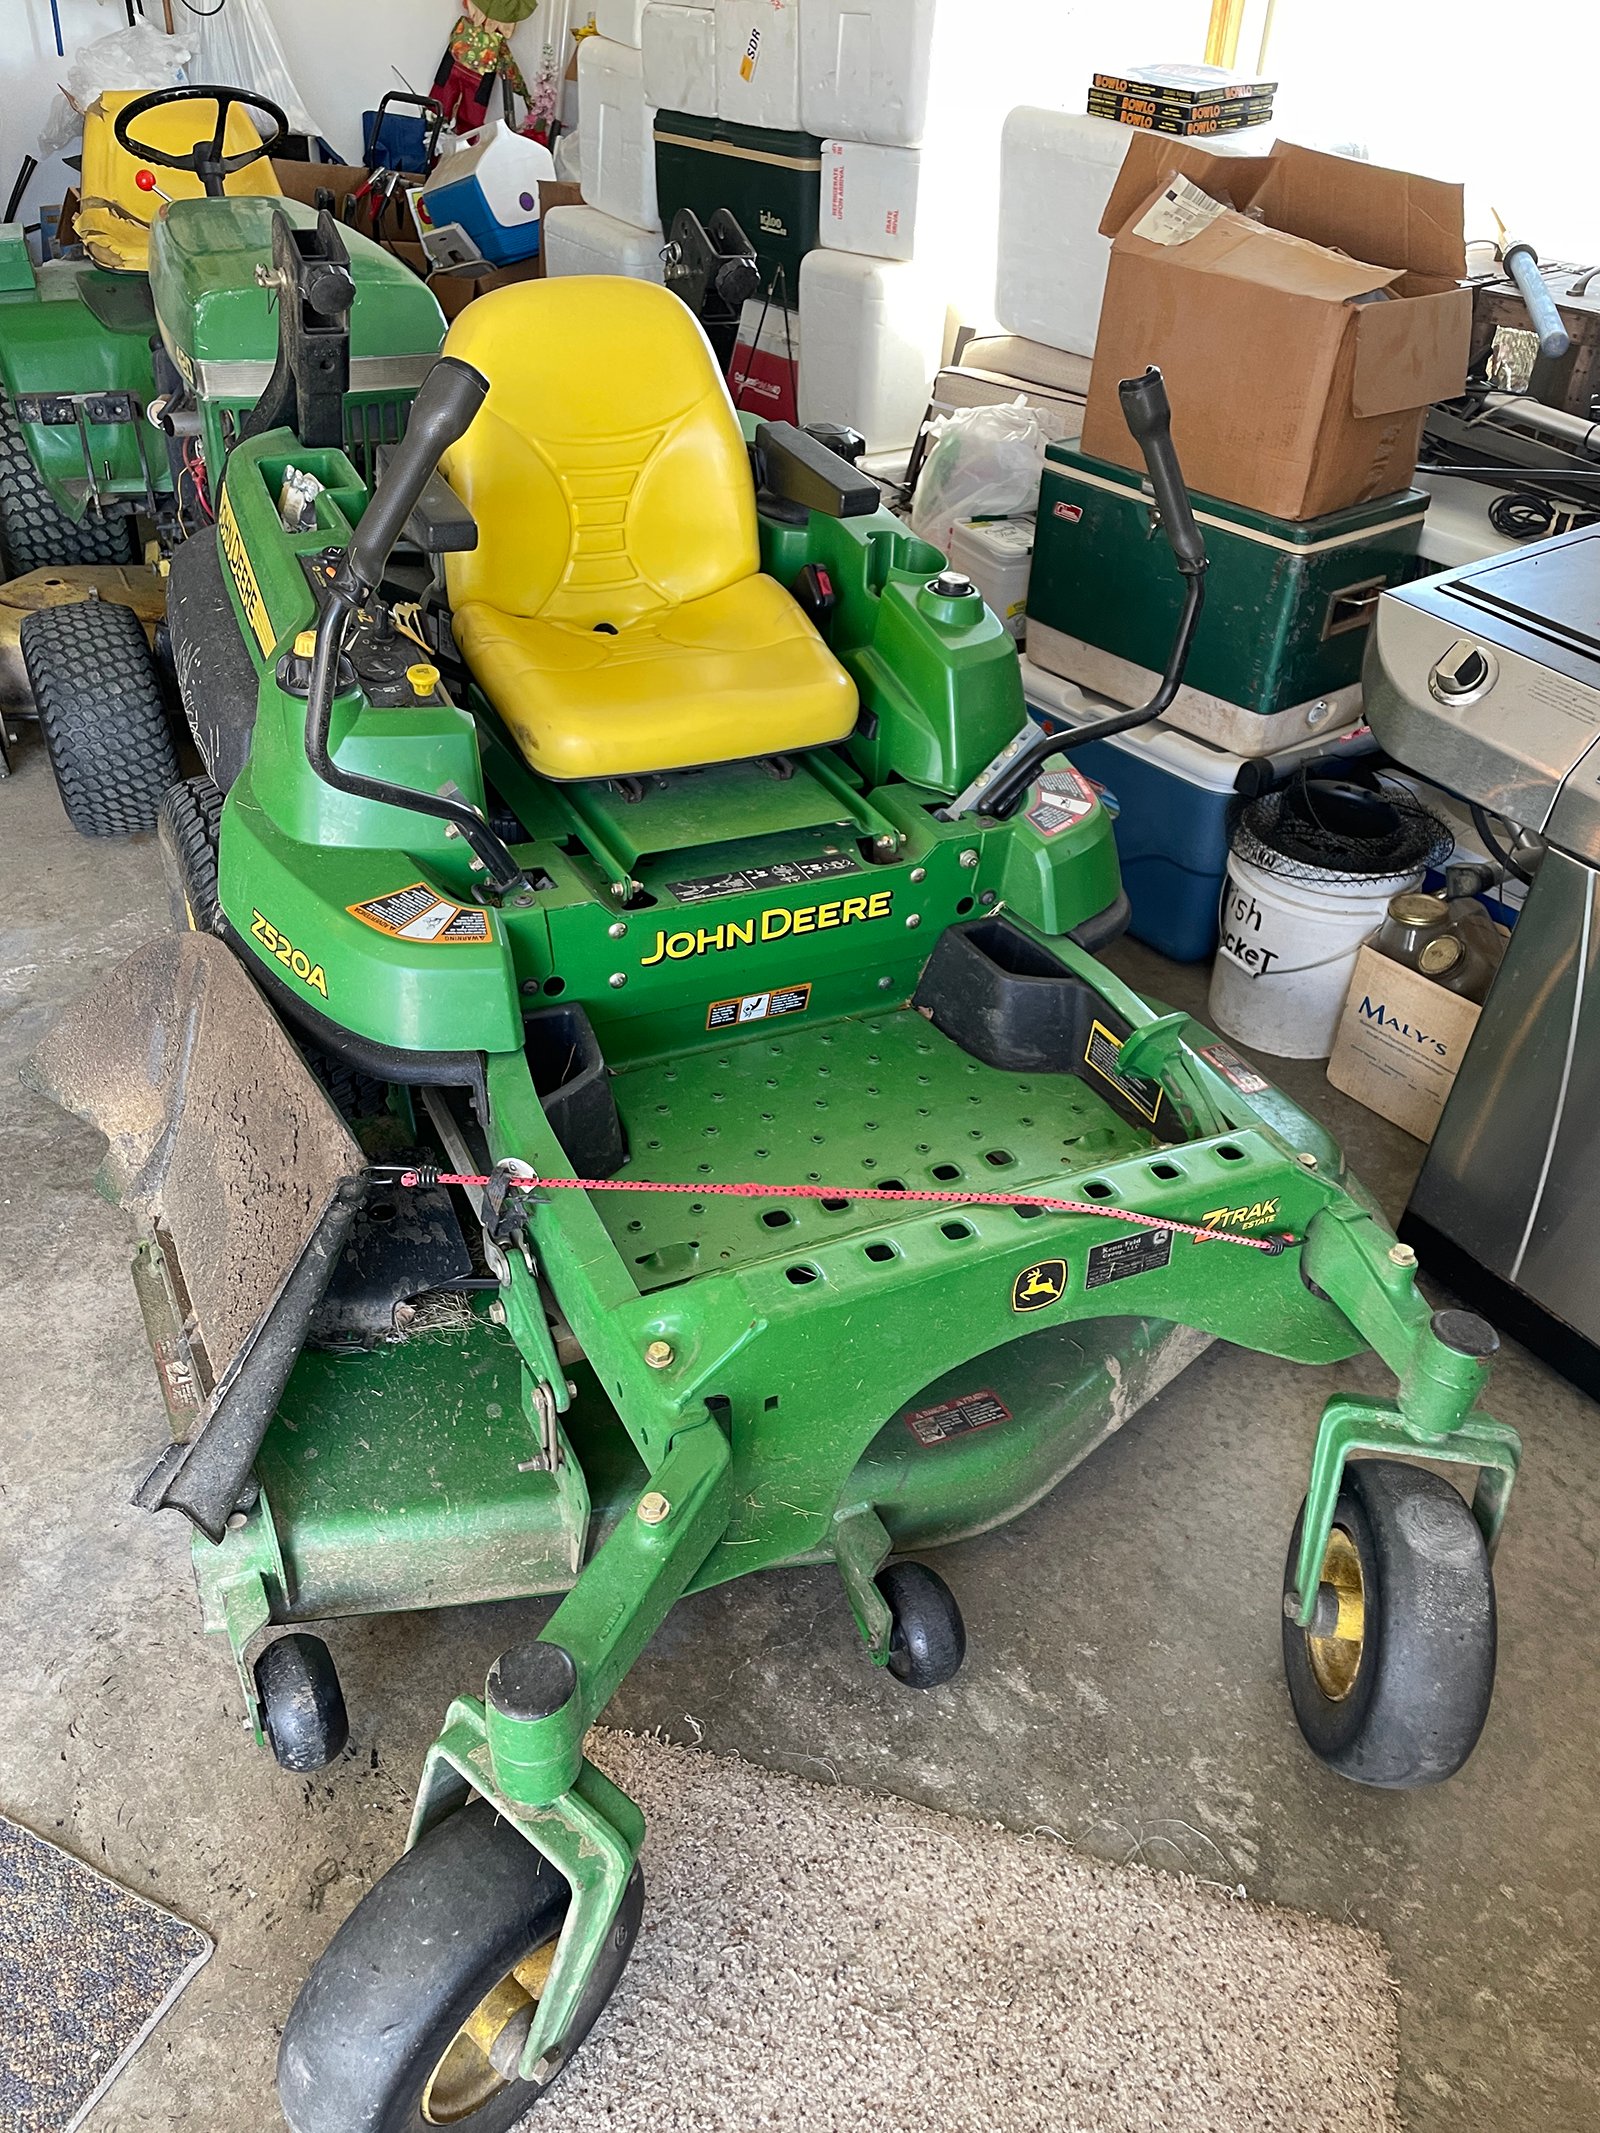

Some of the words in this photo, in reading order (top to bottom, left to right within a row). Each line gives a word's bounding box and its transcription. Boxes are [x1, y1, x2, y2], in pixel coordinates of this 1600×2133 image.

[747, 28, 761, 60] SDR
[1095, 74, 1128, 92] BOWLO
[1225, 85, 1253, 99] BOWLO
[1122, 97, 1156, 115] BOWLO
[1191, 104, 1221, 121] BOWLO
[1120, 110, 1153, 129] BOWLO
[1186, 119, 1217, 136] BOWLO
[837, 197, 845, 220] UPON
[1230, 887, 1263, 932] ish
[640, 917, 755, 966] JOHN
[761, 890, 893, 942] DEERE
[250, 907, 329, 1000] Z520A
[1358, 995, 1448, 1056] MALY'S
[1241, 1214, 1278, 1231] ESTATE
